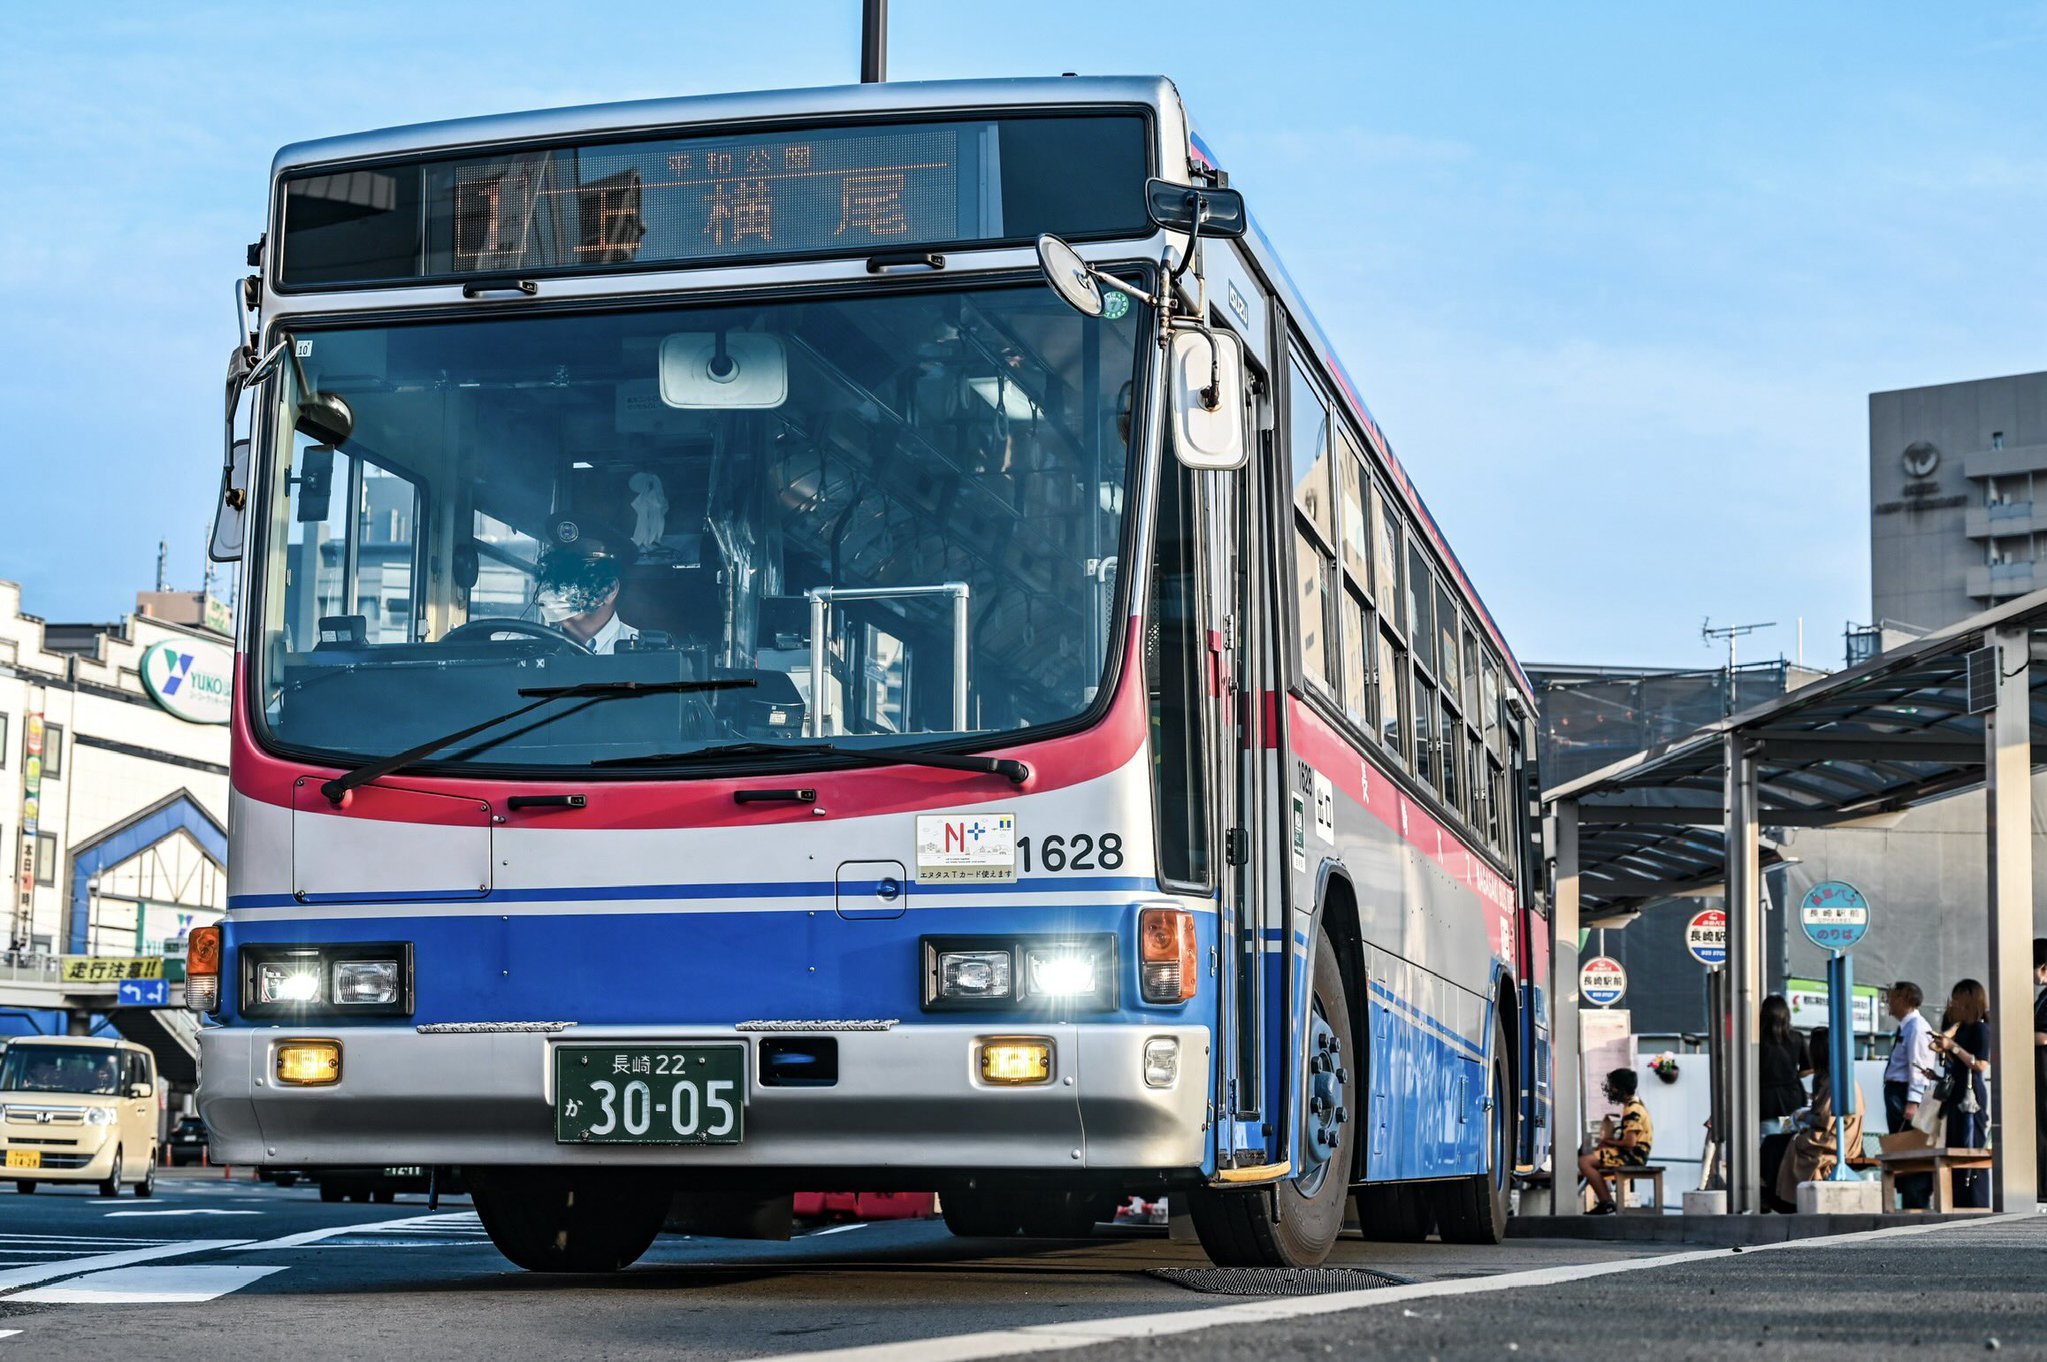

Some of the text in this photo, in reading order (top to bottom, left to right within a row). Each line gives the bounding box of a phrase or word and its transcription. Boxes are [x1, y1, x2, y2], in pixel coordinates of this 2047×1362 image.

[1229, 284, 1248, 324] ISUZU
[191, 671, 223, 695] YUKO
[1317, 787, 1332, 829] 出口
[1016, 832, 1124, 873] 1628
[1691, 930, 1726, 942] 長崎駅
[1817, 929, 1853, 940] のりば
[1584, 976, 1622, 986] 長崎駅前
[564, 1080, 735, 1136] か 30-05
